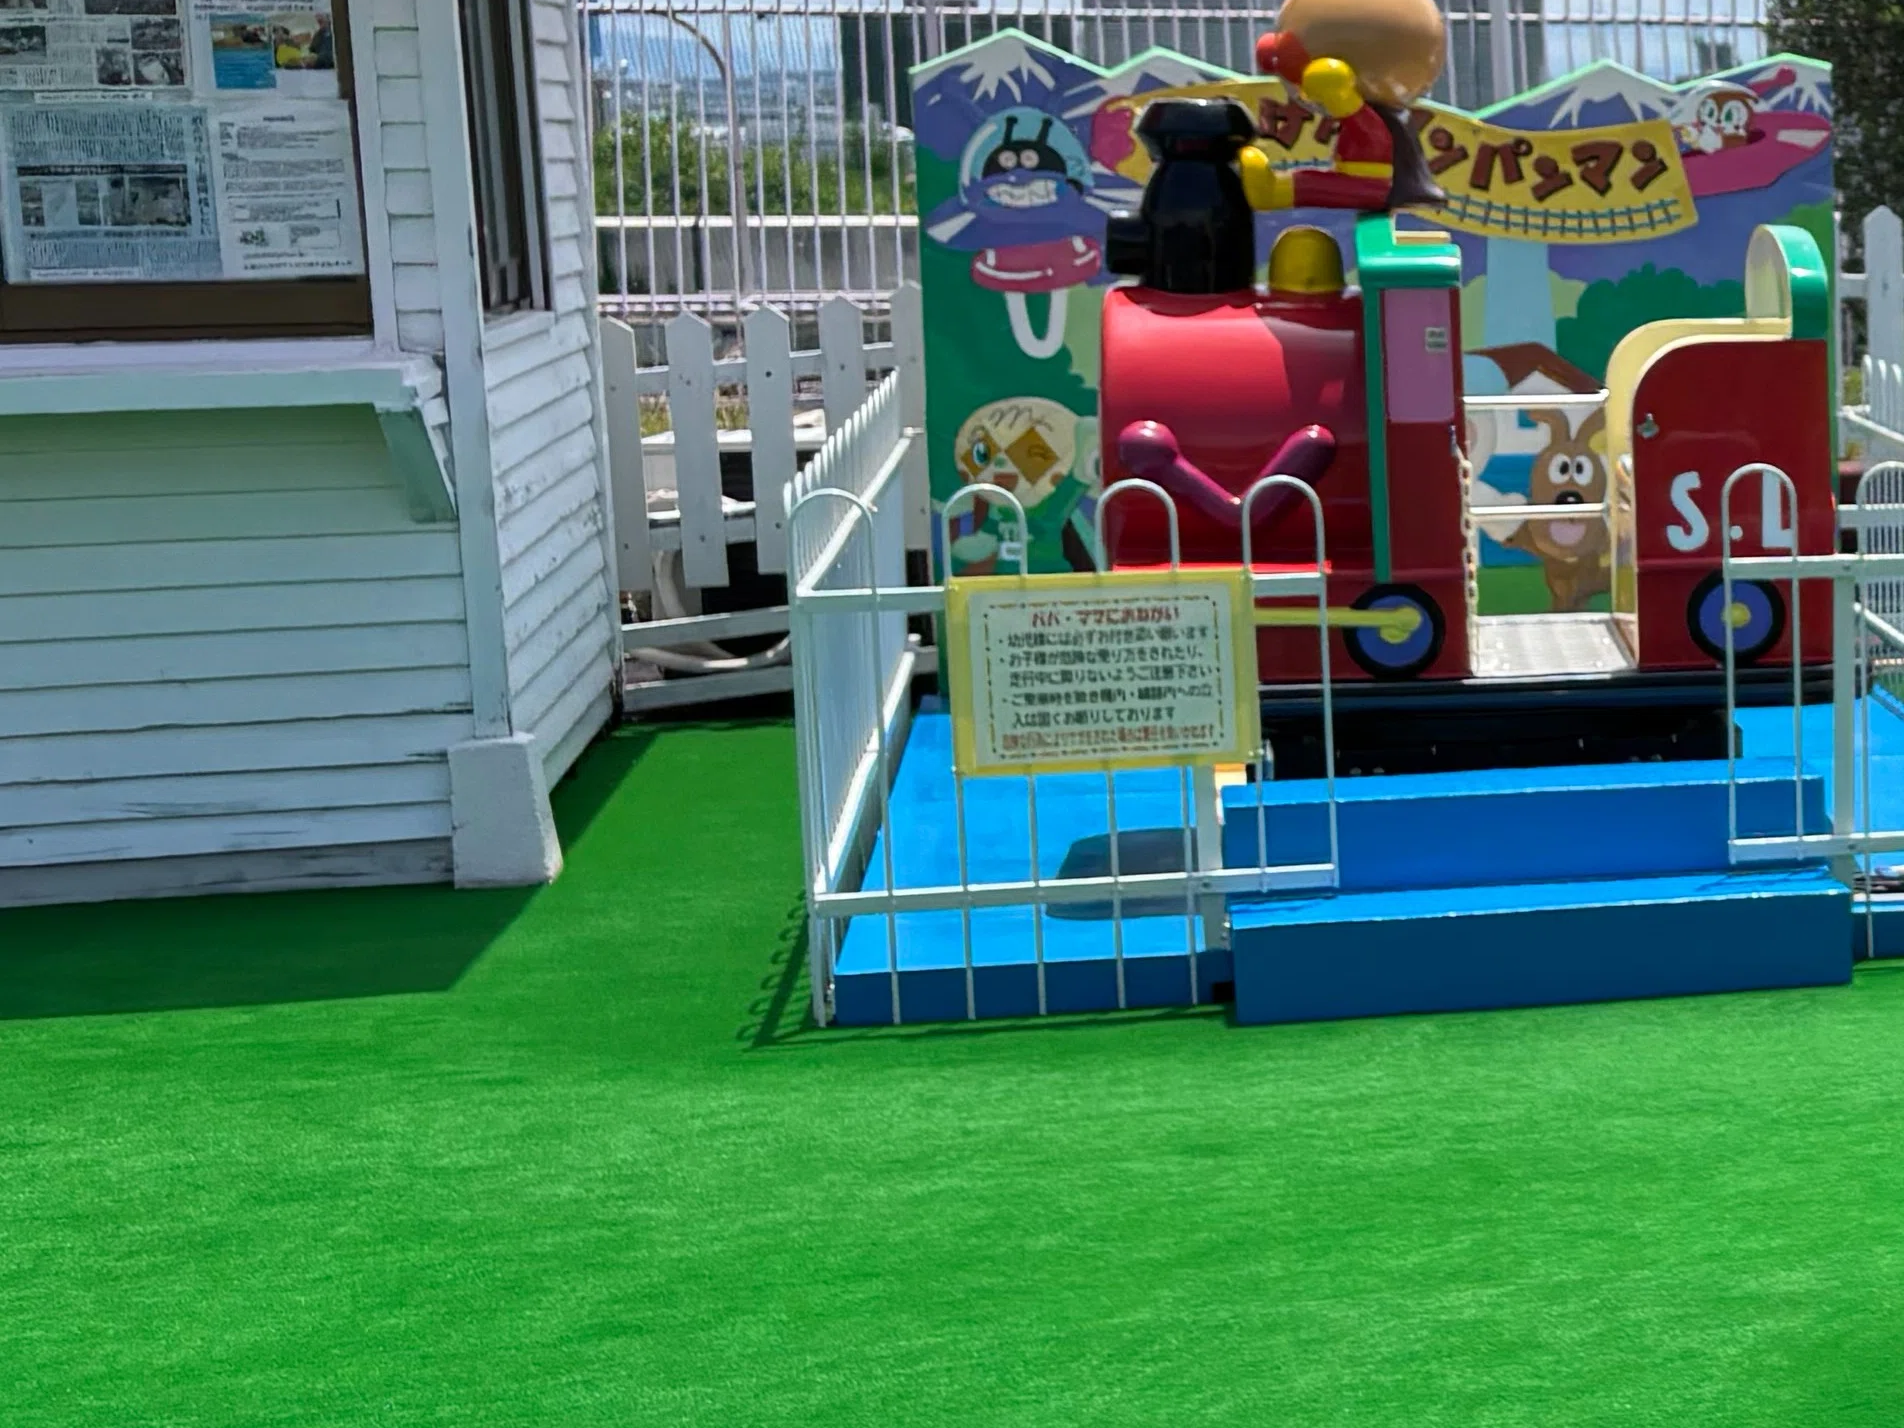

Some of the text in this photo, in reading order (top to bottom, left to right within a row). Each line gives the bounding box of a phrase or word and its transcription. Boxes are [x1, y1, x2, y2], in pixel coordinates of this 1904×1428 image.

[1032, 606, 1179, 628] パパ・ママにおねがい
